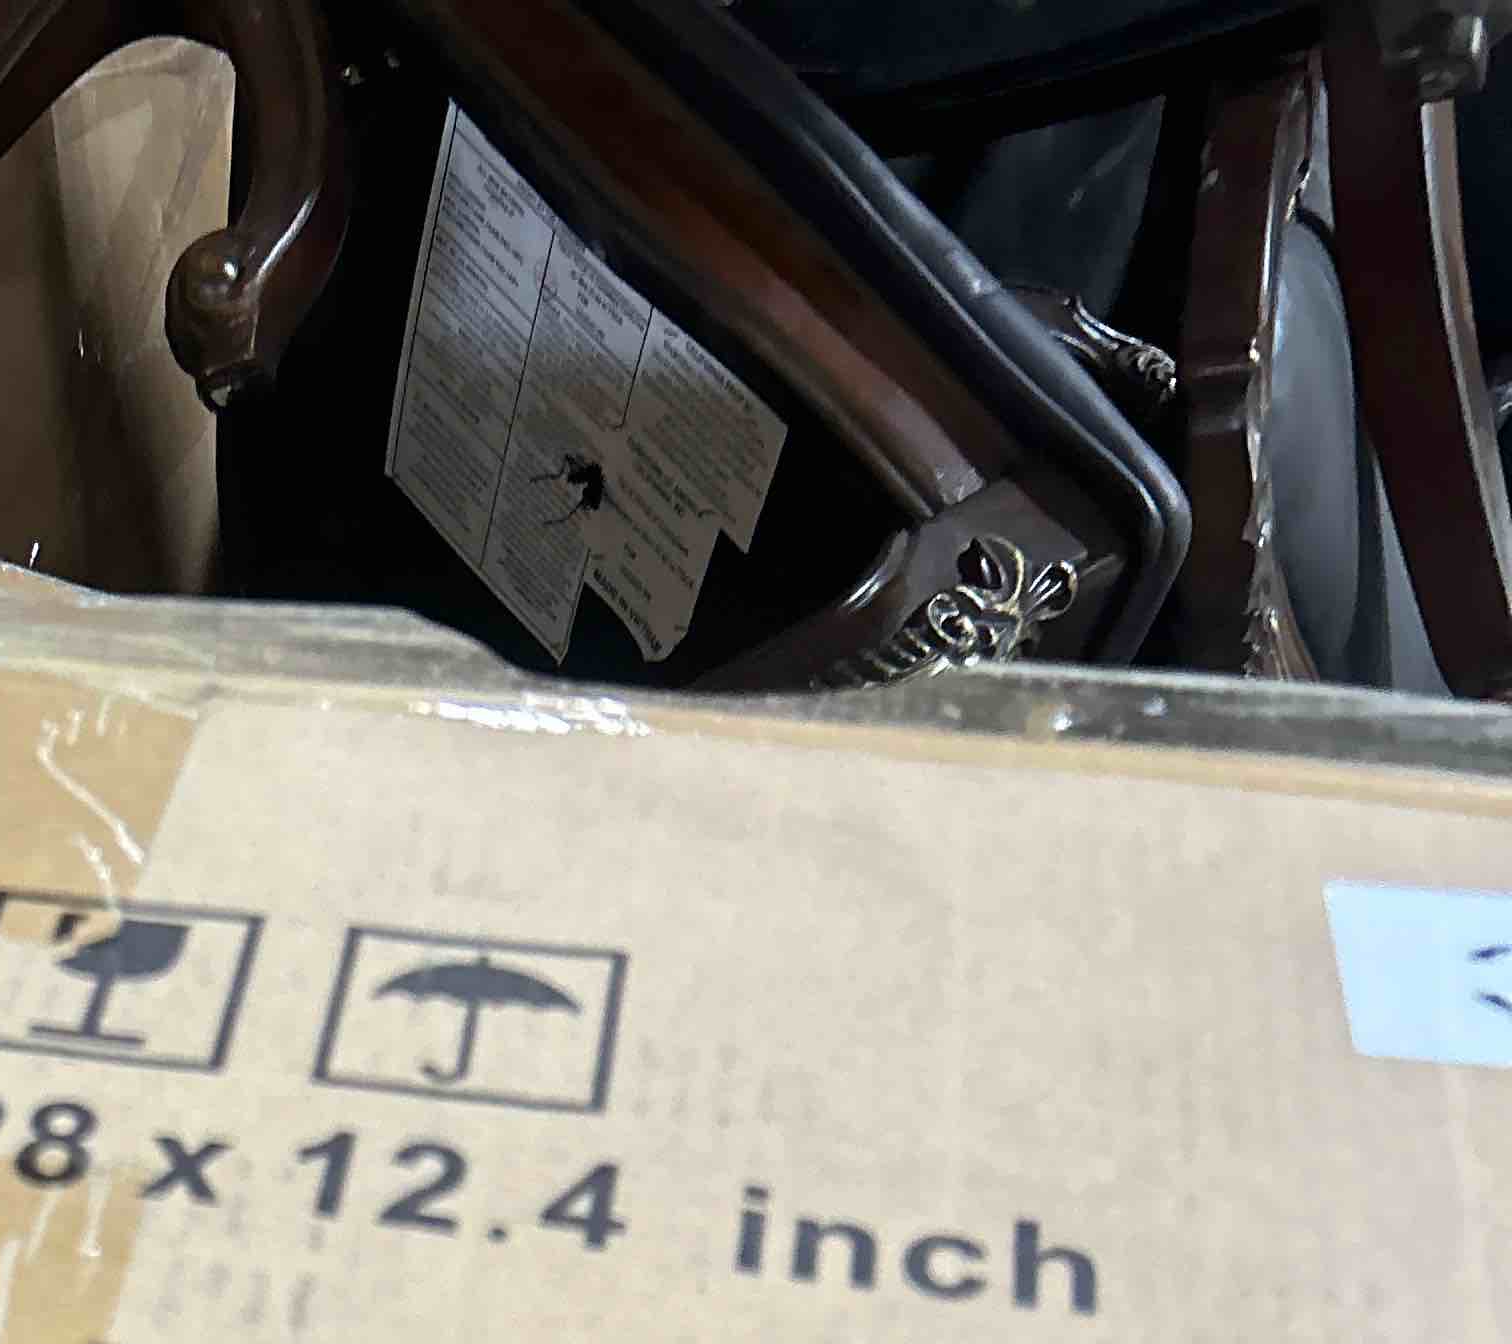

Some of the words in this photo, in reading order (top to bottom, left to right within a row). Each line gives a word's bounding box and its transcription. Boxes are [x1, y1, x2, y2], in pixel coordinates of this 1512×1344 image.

[142, 1131, 228, 1203] x
[297, 1131, 629, 1251] 12.4
[735, 1186, 1098, 1316] inch
